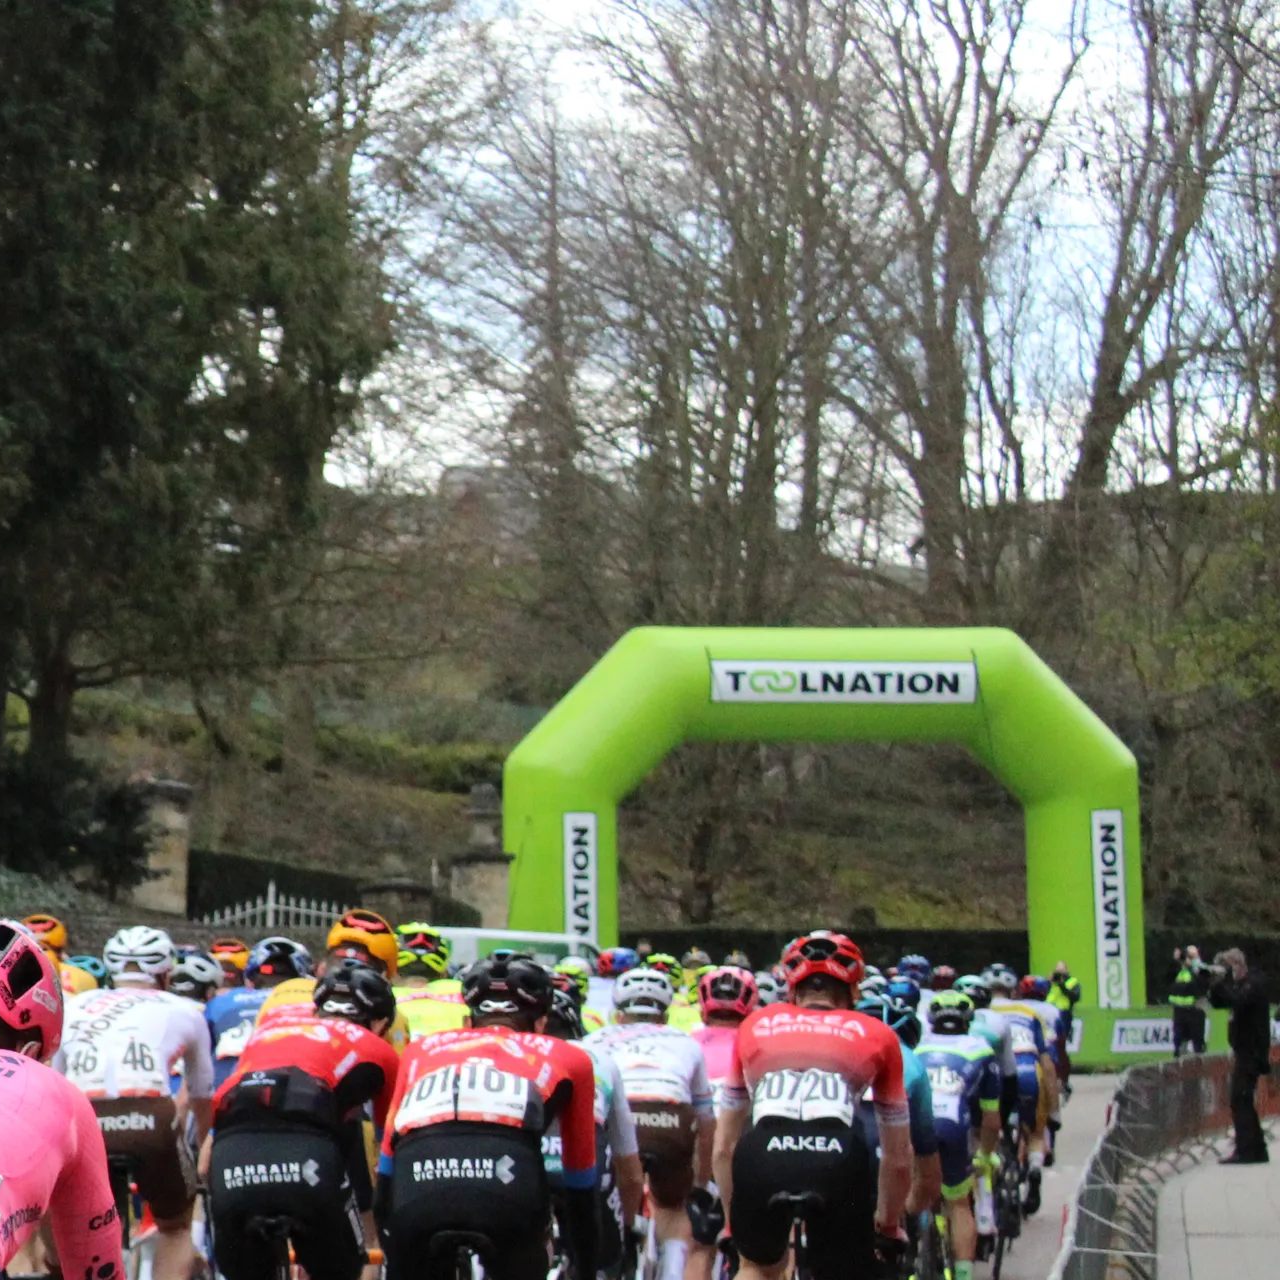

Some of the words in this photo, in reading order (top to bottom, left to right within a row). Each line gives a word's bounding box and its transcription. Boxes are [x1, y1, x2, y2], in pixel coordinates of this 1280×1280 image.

[751, 1013, 866, 1037] ARKEA
[122, 1041, 155, 1072] 46
[465, 1064, 523, 1096] 101
[766, 1135, 843, 1153] ARKEA
[223, 1161, 300, 1180] BAHRAIN
[412, 1157, 493, 1172] BAHRAIN
[225, 1173, 301, 1189] VICTORIOUS
[413, 1168, 493, 1182] VICTORIOUS
